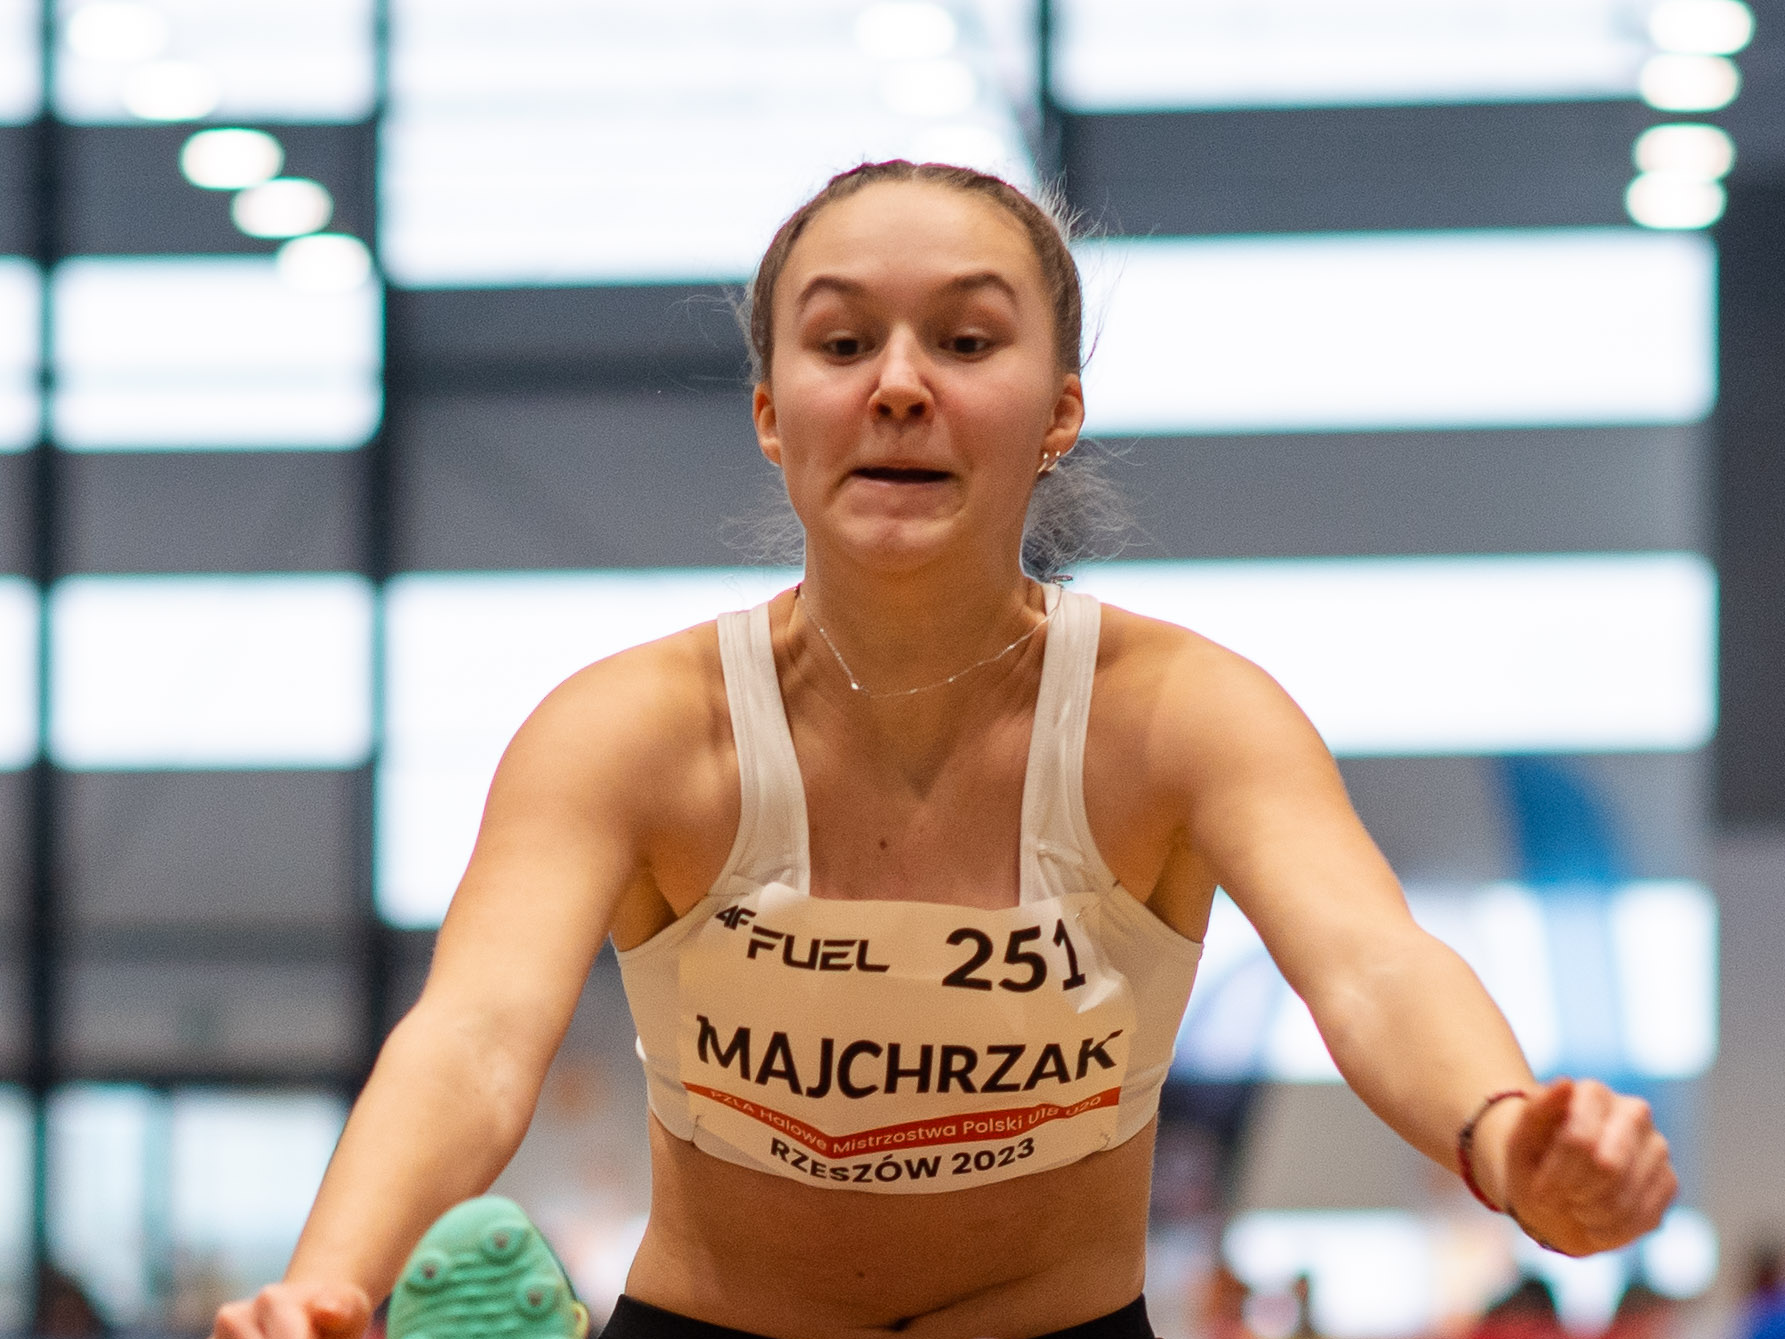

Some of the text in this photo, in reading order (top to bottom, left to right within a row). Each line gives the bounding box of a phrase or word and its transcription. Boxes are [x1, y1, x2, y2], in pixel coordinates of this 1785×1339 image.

[714, 904, 757, 930] 4F
[746, 925, 890, 972] FUEL
[942, 917, 1086, 993] 251
[696, 1014, 1123, 1099] MAJCHRZAK
[759, 1109, 827, 1153] Halowe
[833, 1124, 957, 1153] Mistrzostwa
[963, 1115, 1023, 1135] Polski
[1028, 1107, 1059, 1125] U18
[770, 1136, 1036, 1184] RZESZÓW 2023
